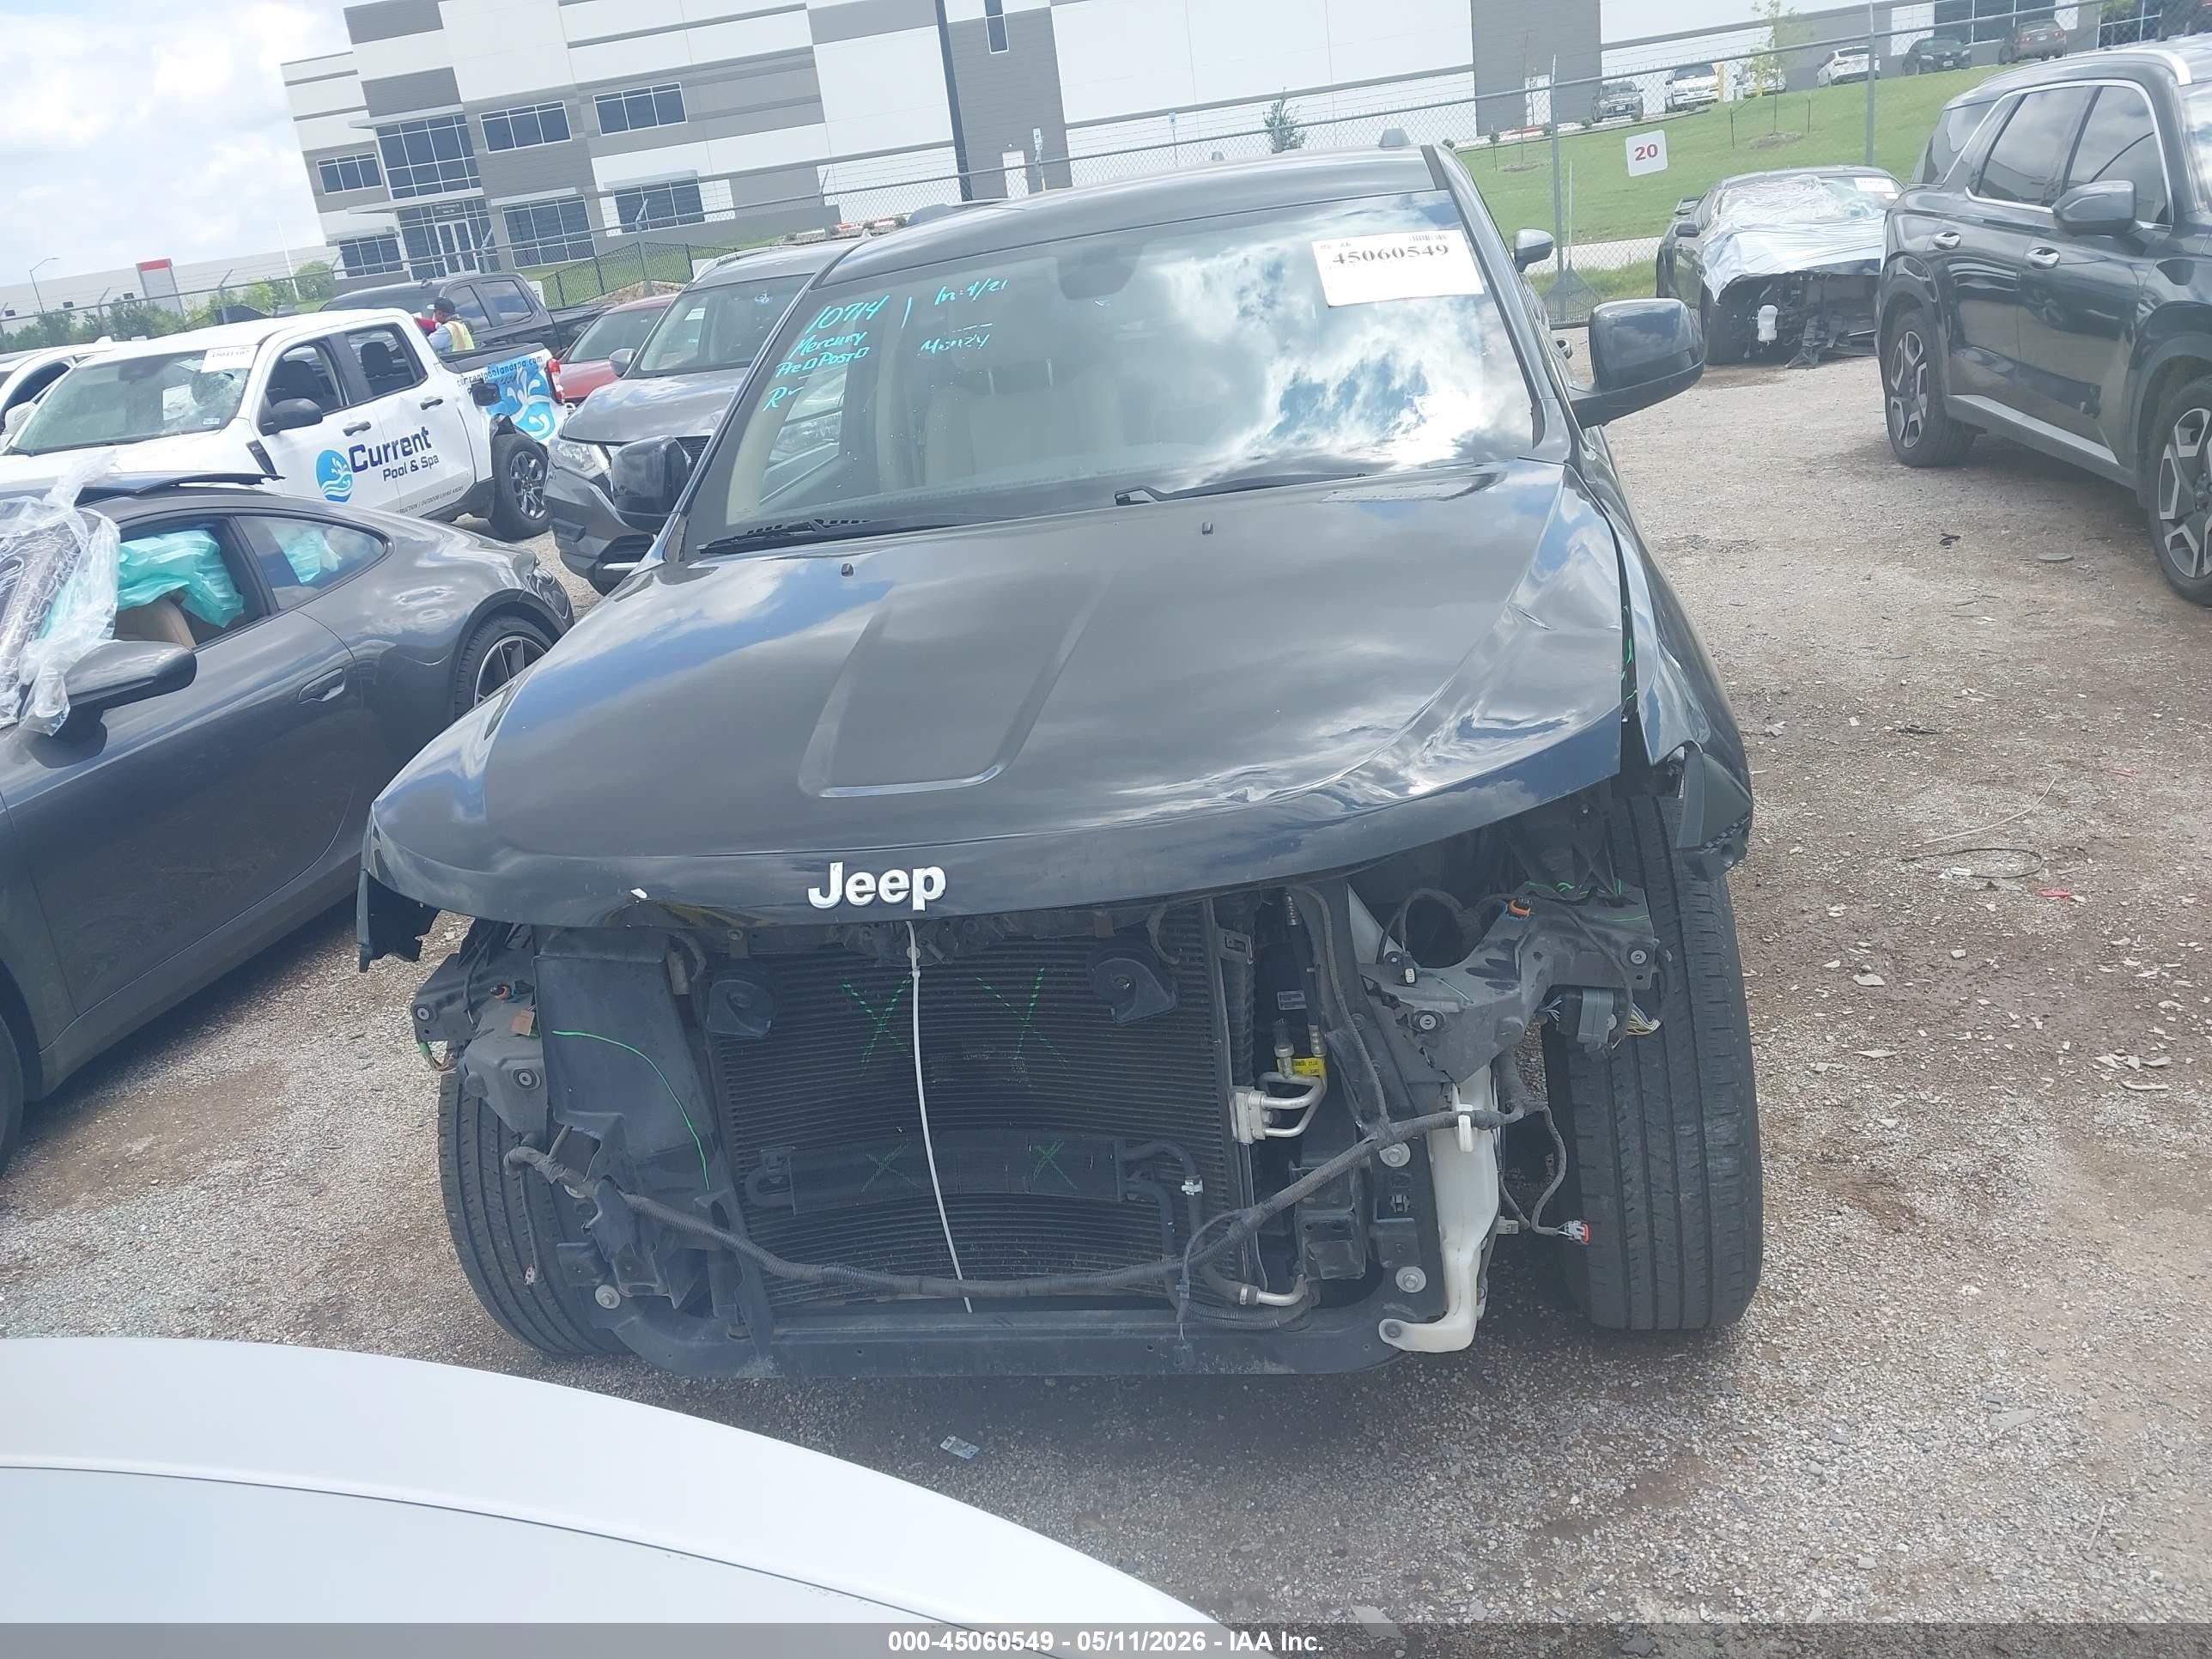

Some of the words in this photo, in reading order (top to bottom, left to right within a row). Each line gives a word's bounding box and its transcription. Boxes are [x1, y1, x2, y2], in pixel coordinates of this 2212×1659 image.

[1634, 143, 1658, 161] 20
[1332, 244, 1449, 264] 45060549
[805, 295, 890, 334] 10714
[788, 331, 868, 360] Mercury
[348, 426, 433, 474] Current
[382, 462, 408, 482] Pool
[410, 459, 419, 472] &
[420, 454, 440, 470] Spa
[807, 860, 947, 912] Jeep
